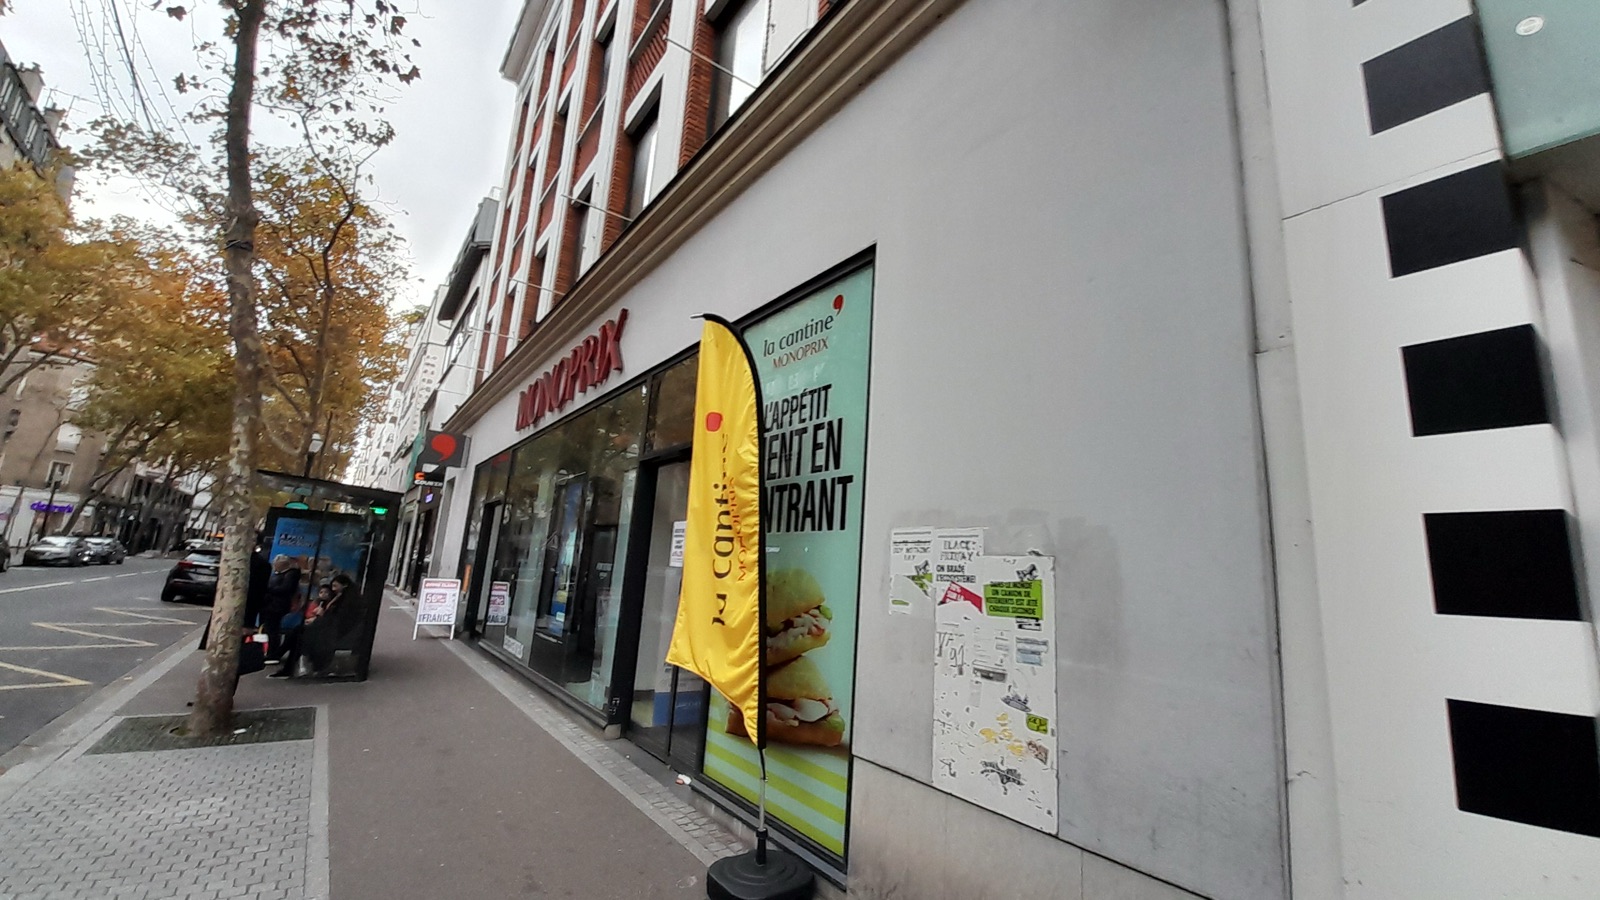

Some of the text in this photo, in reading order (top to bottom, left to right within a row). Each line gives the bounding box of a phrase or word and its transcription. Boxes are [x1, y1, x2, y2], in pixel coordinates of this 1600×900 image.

[763, 314, 834, 358] la cantine
[772, 336, 829, 369] MONOPRIX
[515, 307, 628, 432] MONOPRIX
[810, 417, 843, 475] EN
